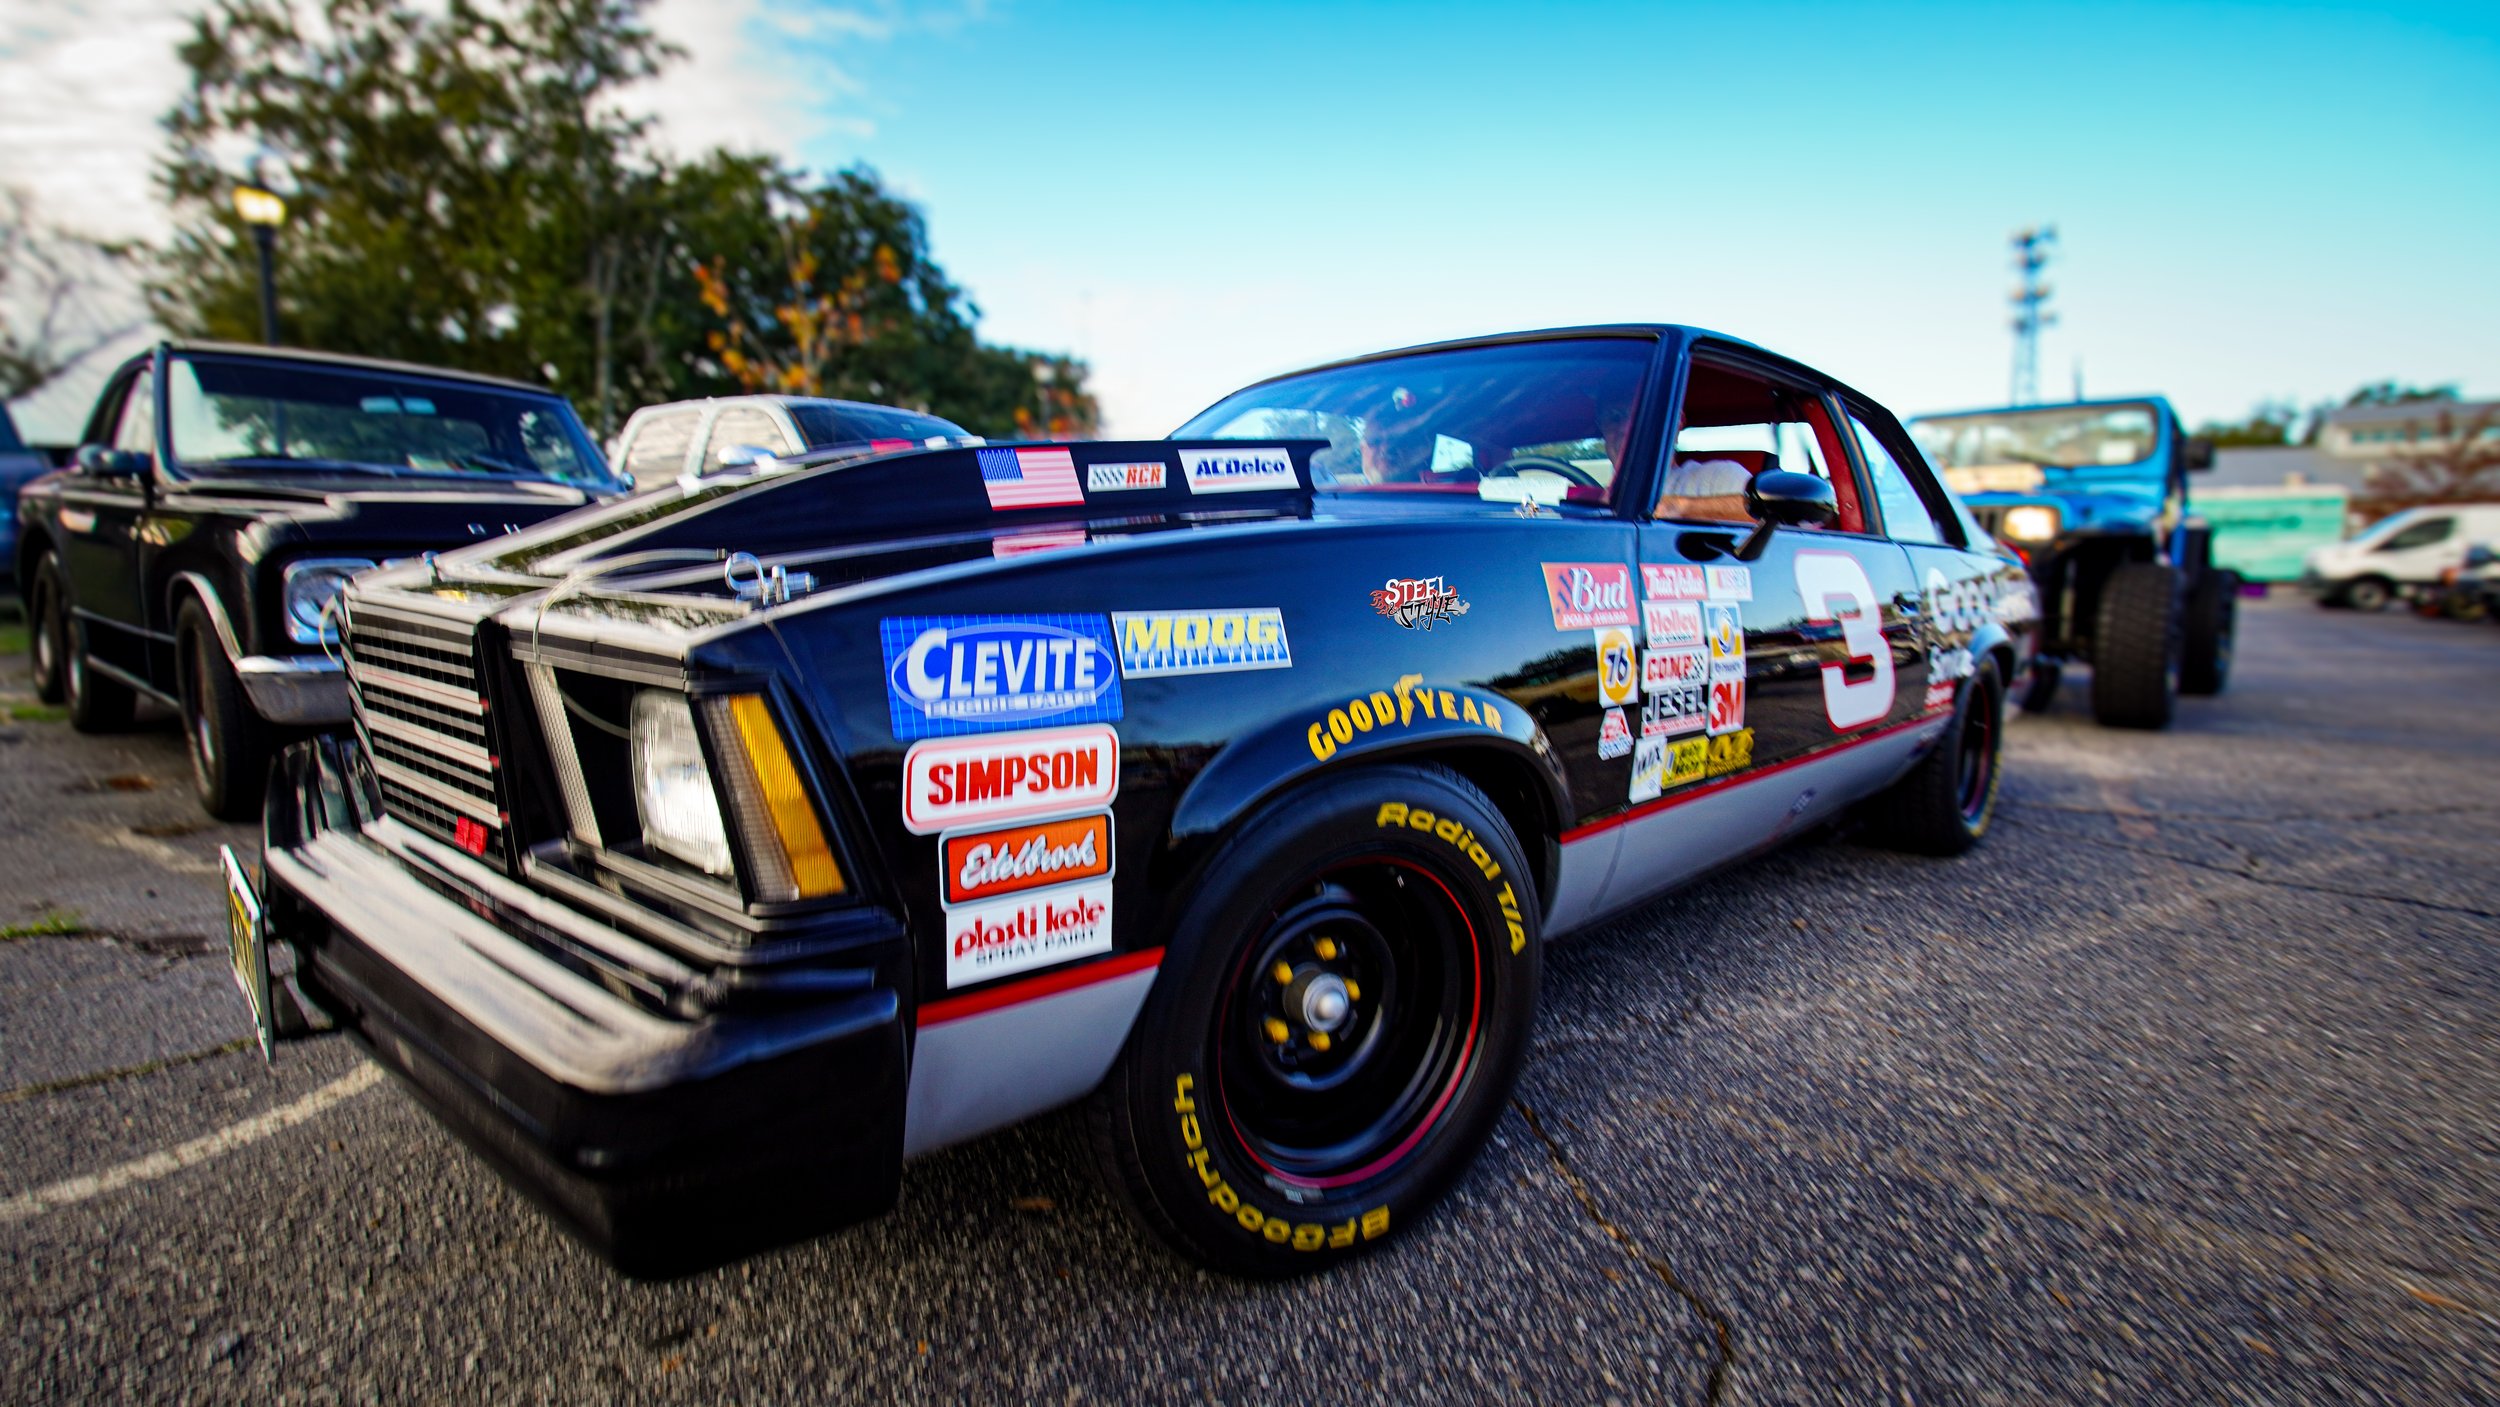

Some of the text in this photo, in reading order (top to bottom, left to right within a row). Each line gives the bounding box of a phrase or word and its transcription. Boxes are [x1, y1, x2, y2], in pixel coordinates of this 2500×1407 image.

[1196, 456, 1286, 478] ACDelco
[1384, 576, 1453, 605] STEEL
[1387, 594, 1460, 632] & STYLE
[1570, 568, 1629, 613] Bud
[1124, 613, 1279, 653] MOOG
[1649, 608, 1699, 636] Holley
[1794, 550, 1896, 734] 3
[906, 628, 1097, 700] CLEVITE
[1604, 643, 1630, 689] 76
[1642, 686, 1707, 726] JESEL
[1709, 681, 1744, 730] 3M
[927, 747, 1098, 808] SIMPSON
[960, 828, 1098, 891] Edelbrock
[1376, 802, 1526, 956] Radial T/A
[954, 893, 1106, 962] plasti kote
[975, 927, 1096, 966] SPRAY PAINT
[1173, 1073, 1390, 1252] BFGoodrich
